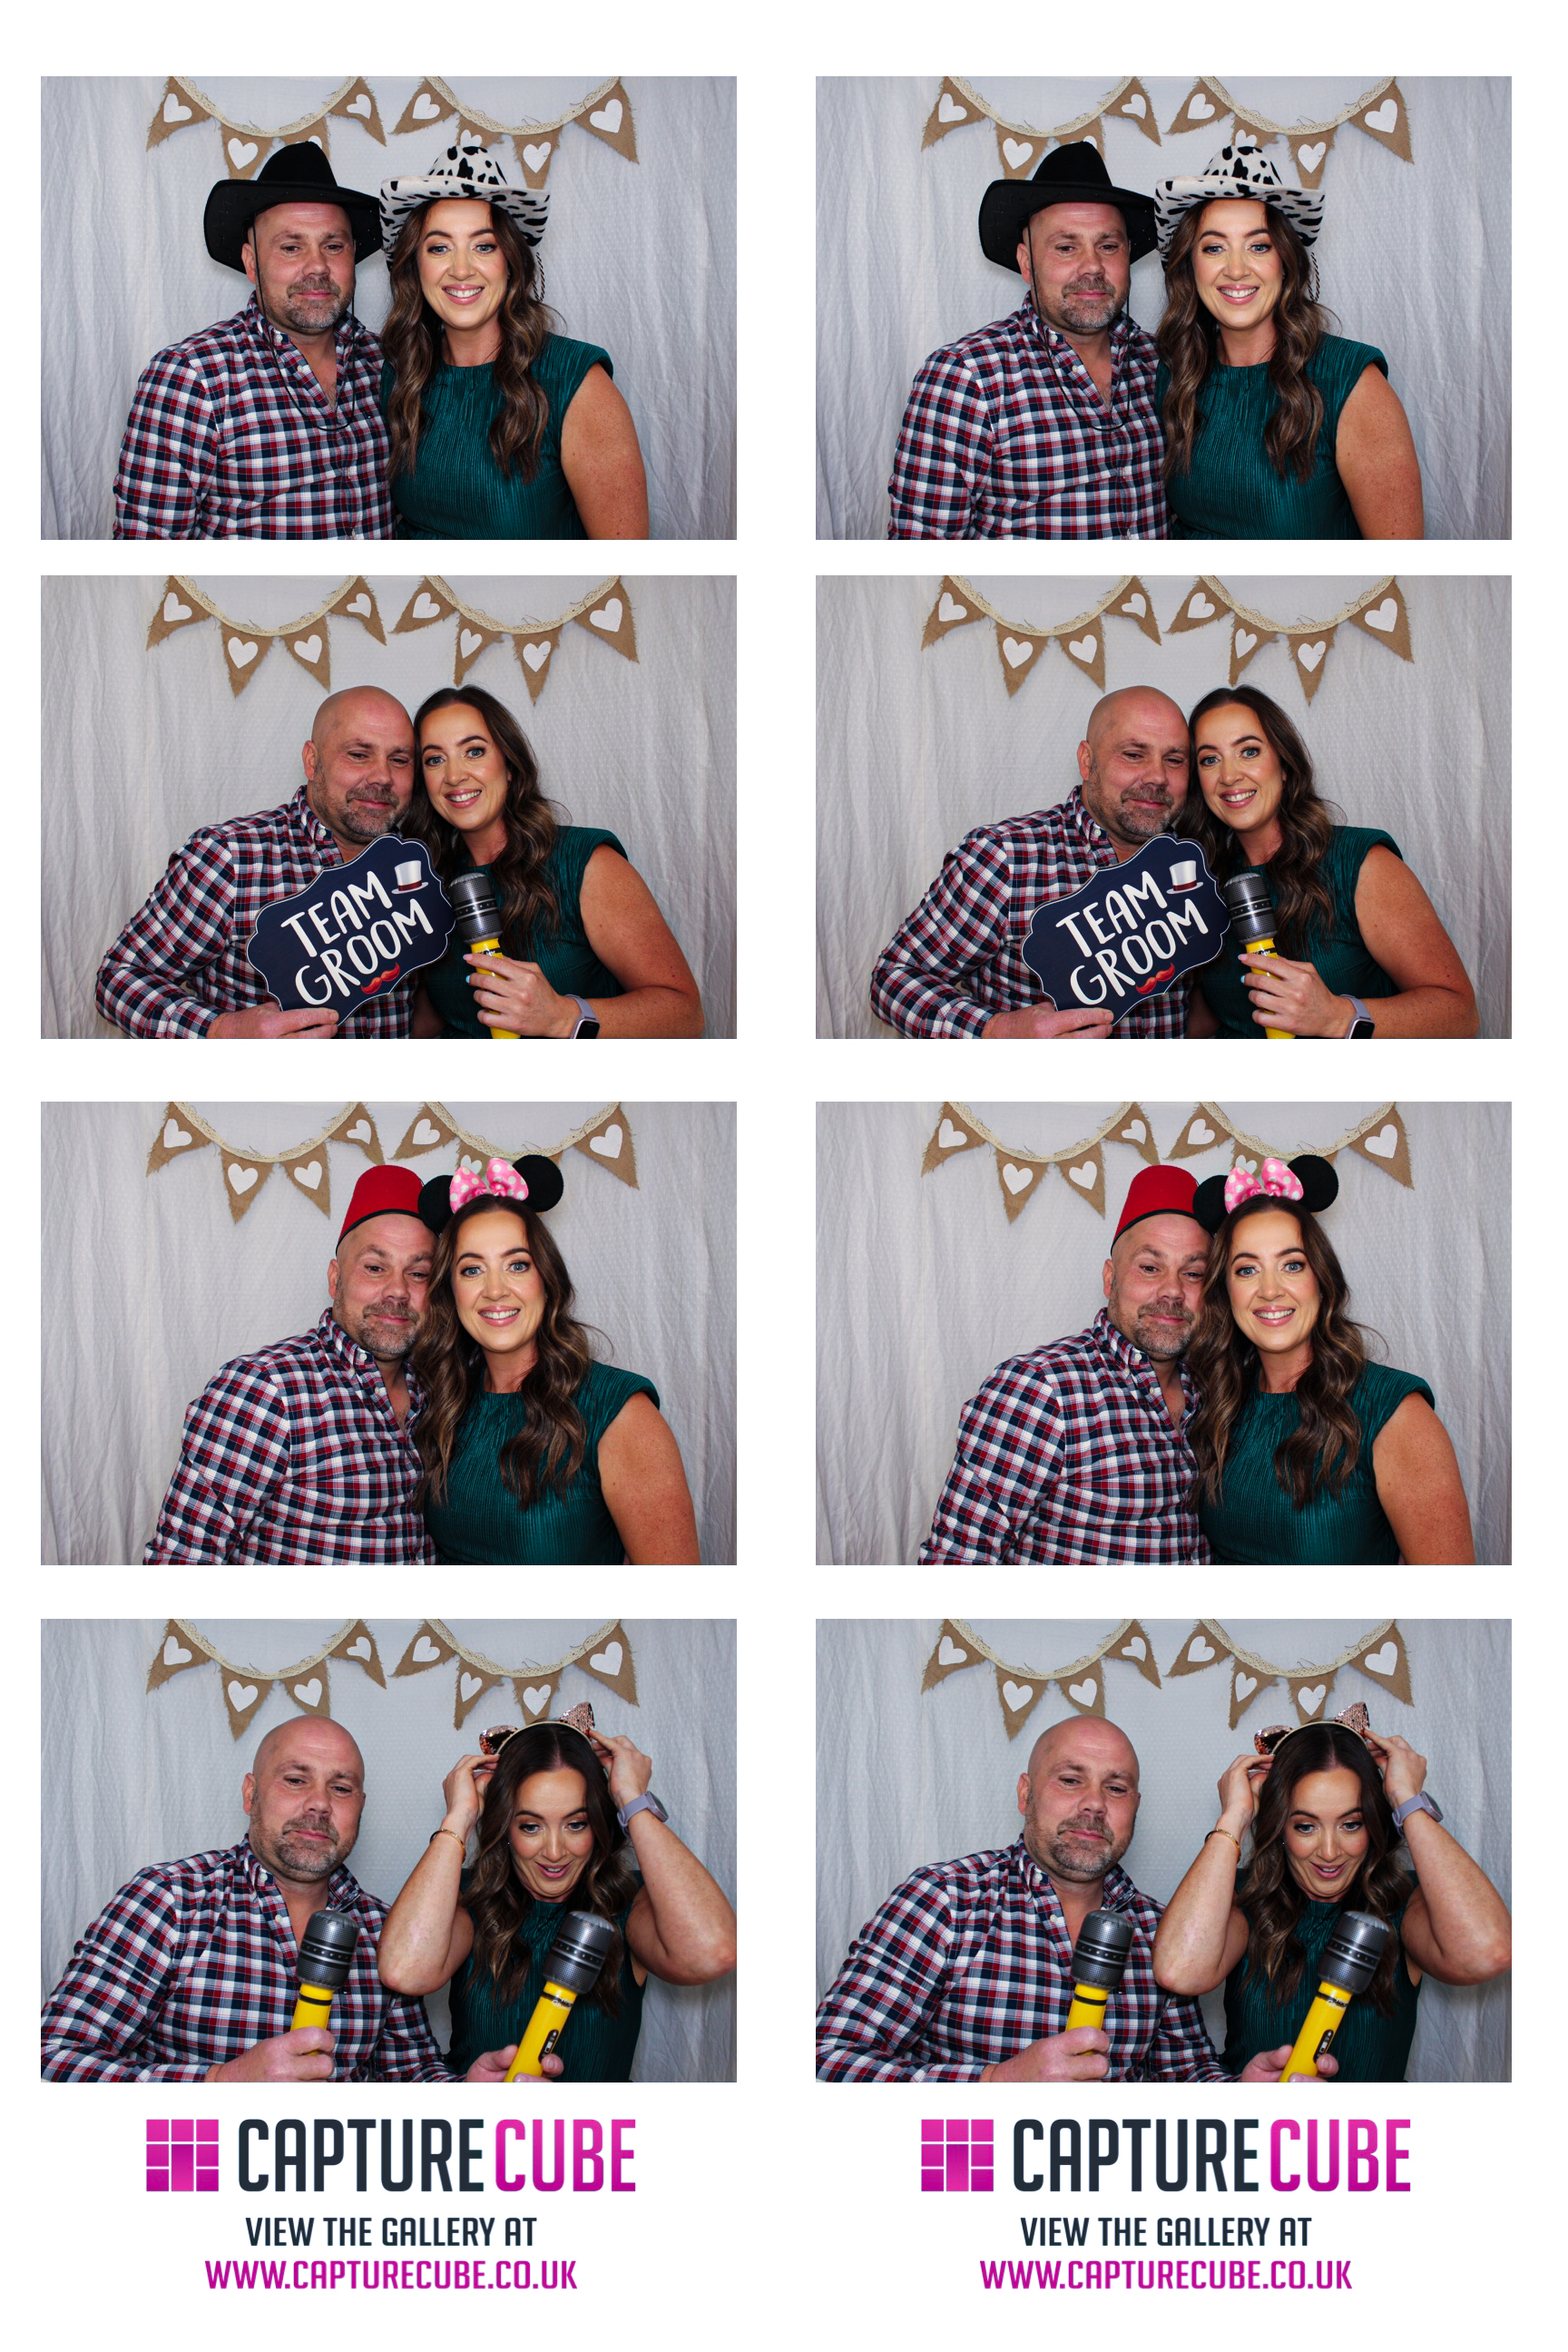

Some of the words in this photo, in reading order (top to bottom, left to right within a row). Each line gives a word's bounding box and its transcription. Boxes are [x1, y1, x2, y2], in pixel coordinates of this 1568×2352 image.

[280, 870, 393, 958] TEAM
[295, 898, 434, 1005] GROOM
[1055, 870, 1168, 958] TEAM
[1070, 898, 1209, 1005] GROOM
